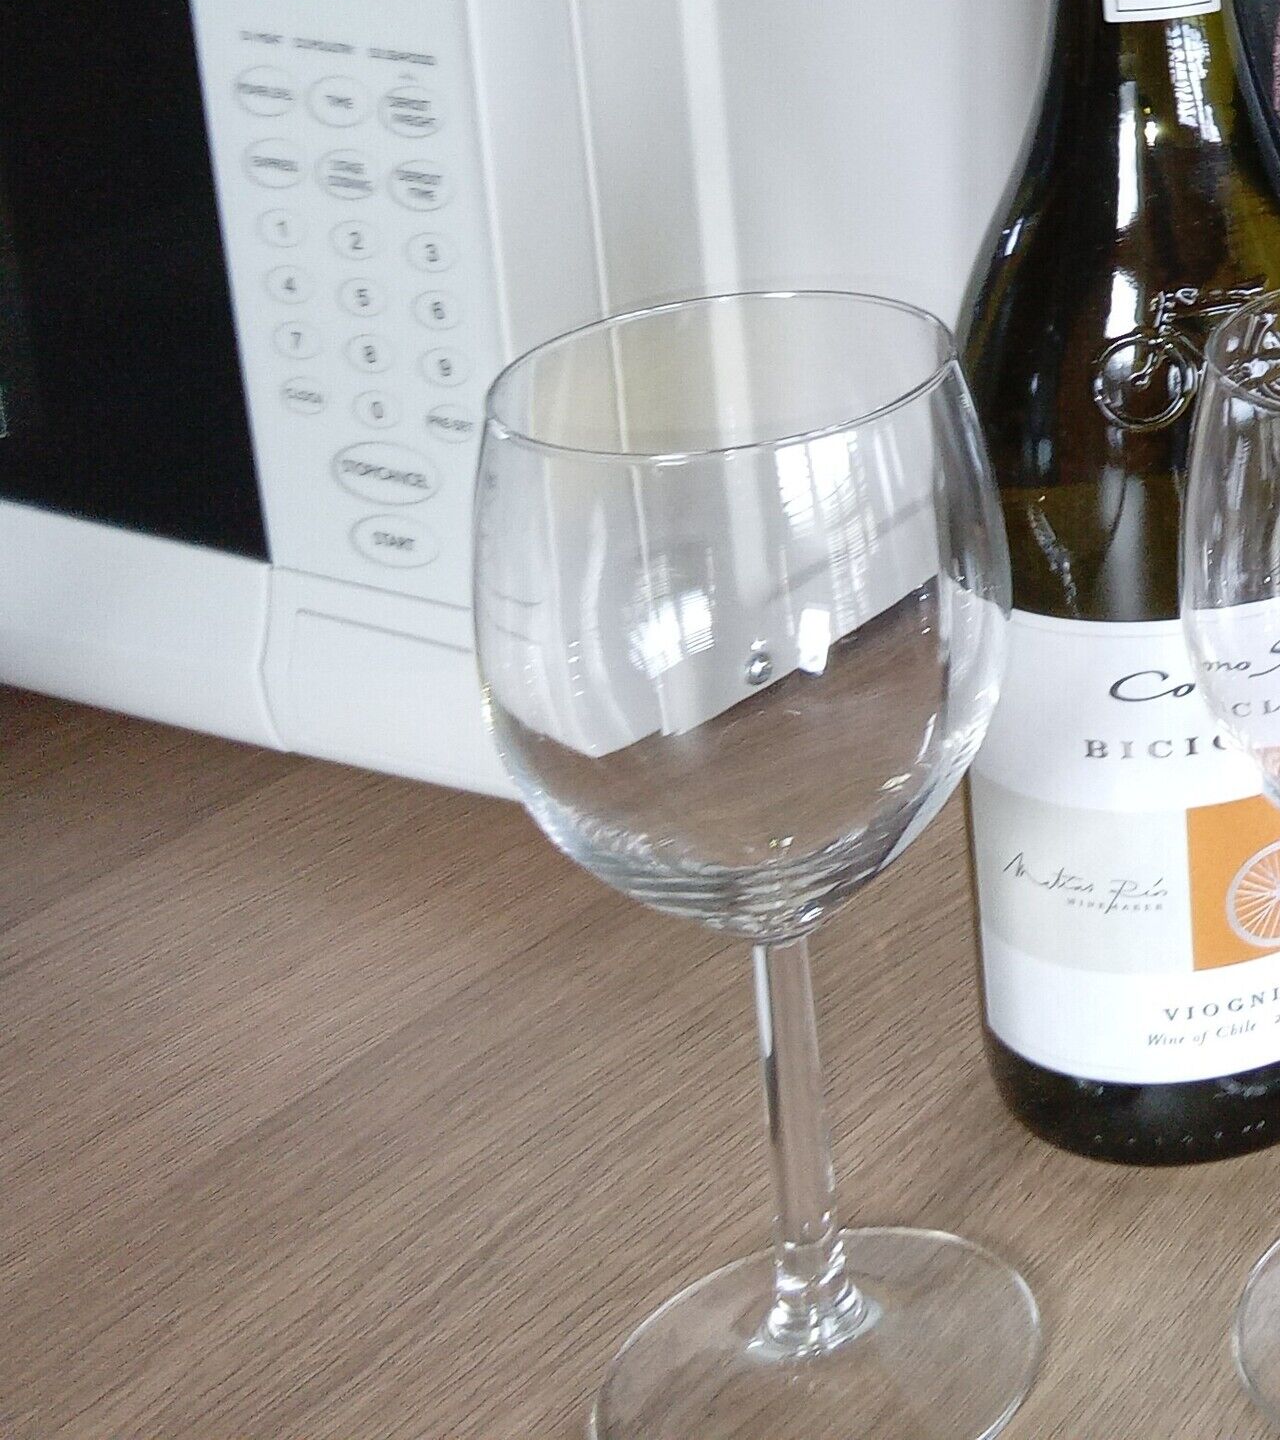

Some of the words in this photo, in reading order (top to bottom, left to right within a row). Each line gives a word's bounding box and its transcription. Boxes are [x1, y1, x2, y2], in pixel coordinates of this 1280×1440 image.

[1148, 1033, 1185, 1047] Wine
[1193, 1031, 1207, 1046] of
[1216, 1020, 1257, 1039] Chile
